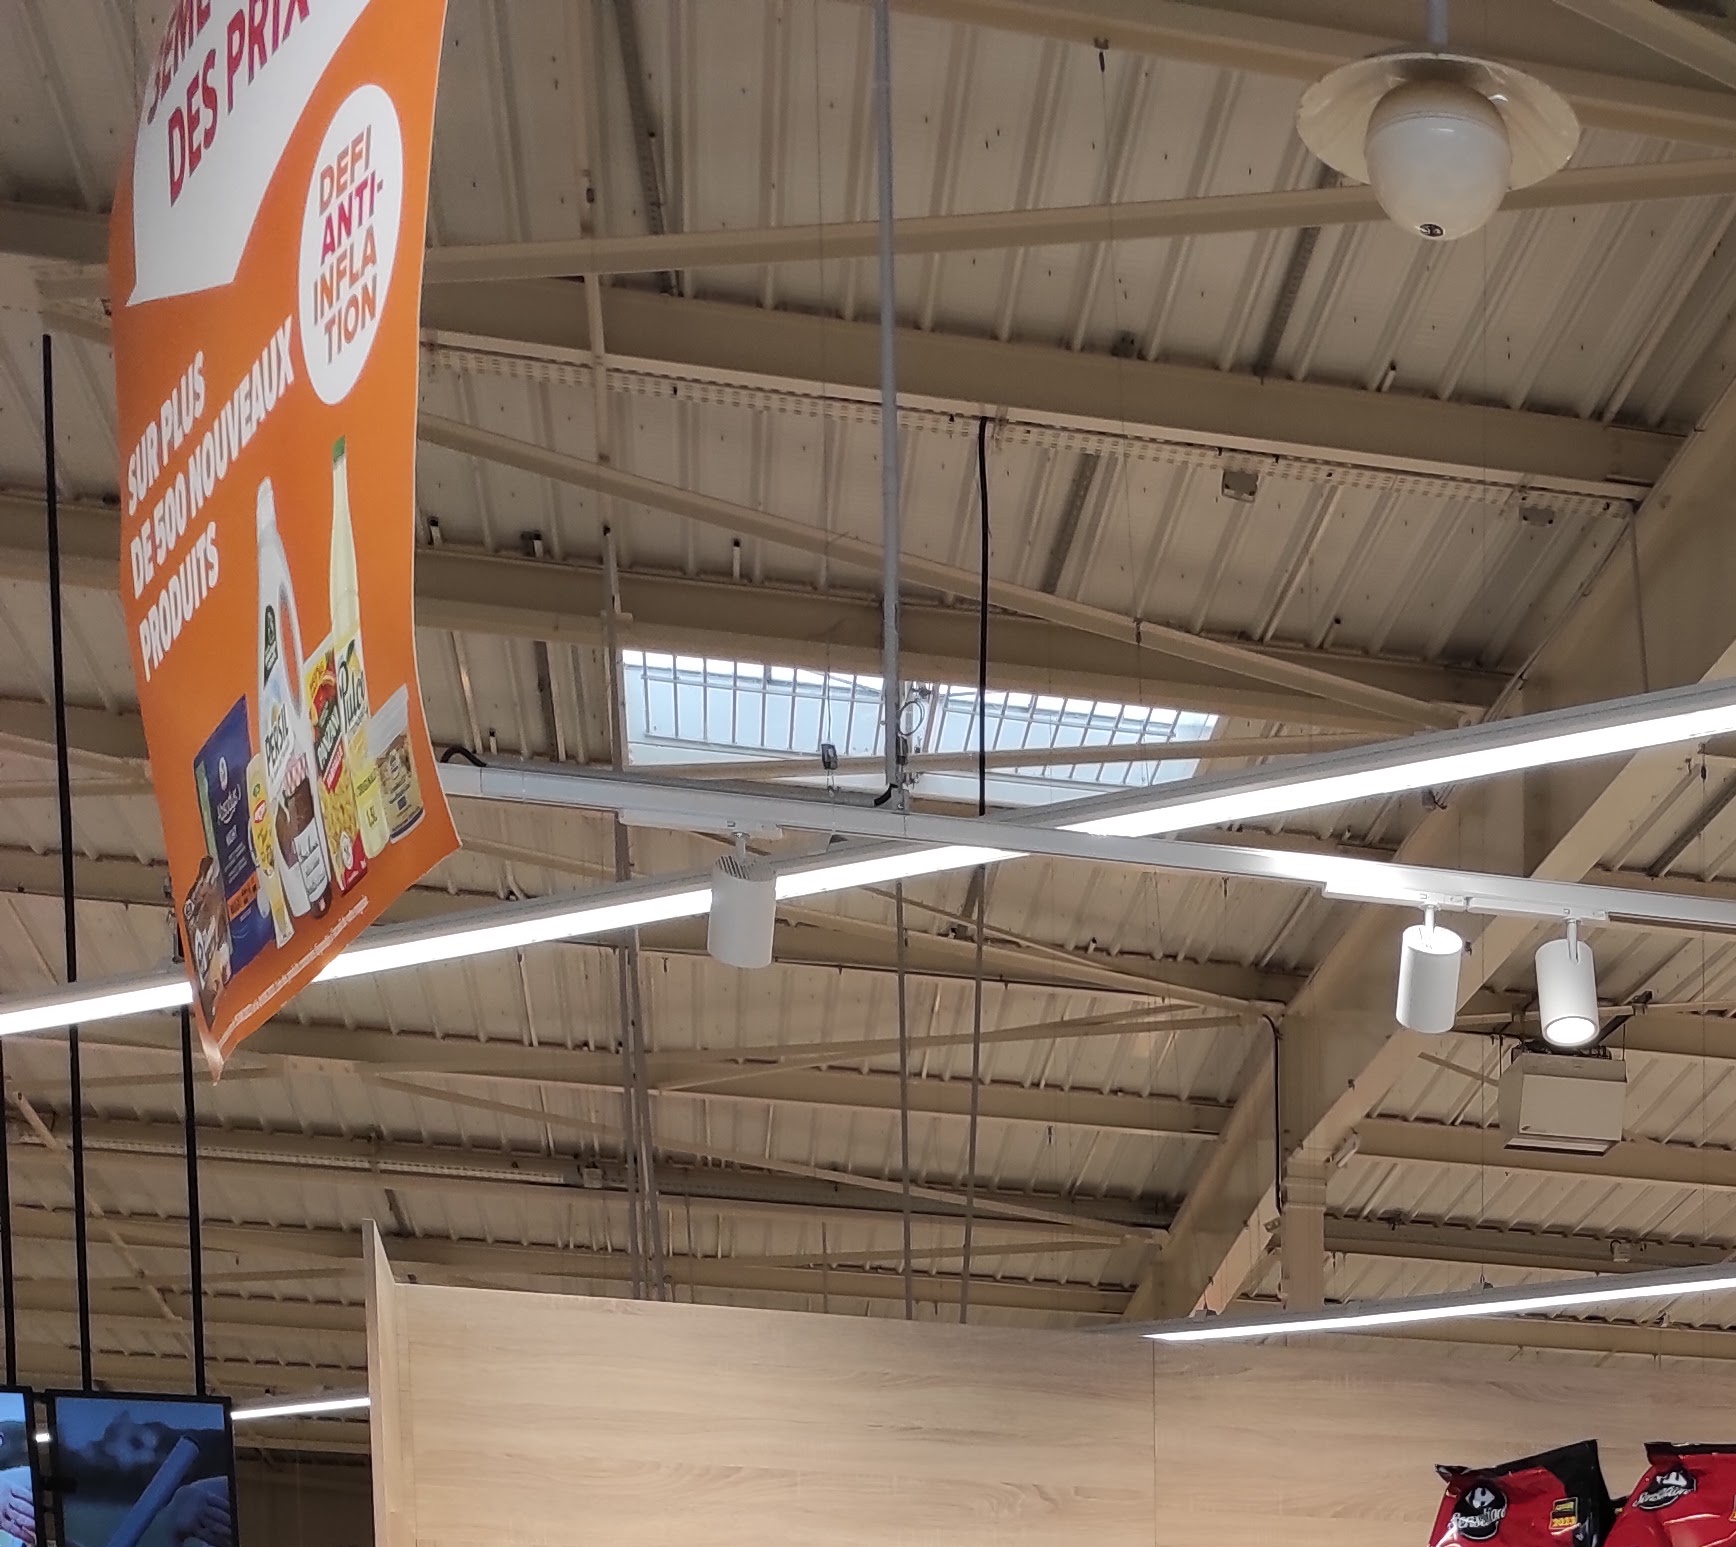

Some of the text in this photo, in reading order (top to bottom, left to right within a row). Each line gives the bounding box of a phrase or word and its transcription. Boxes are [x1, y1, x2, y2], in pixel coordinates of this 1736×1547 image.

[168, 48, 218, 208] DES
[318, 124, 372, 217] DEFI
[313, 225, 378, 326] INFLA
[319, 170, 384, 268] ANTI-
[323, 272, 378, 365] TION
[127, 350, 207, 516] SUR PLUS
[130, 314, 295, 600] DE 500 NOUVEAUX
[139, 521, 220, 683] PRODUITS
